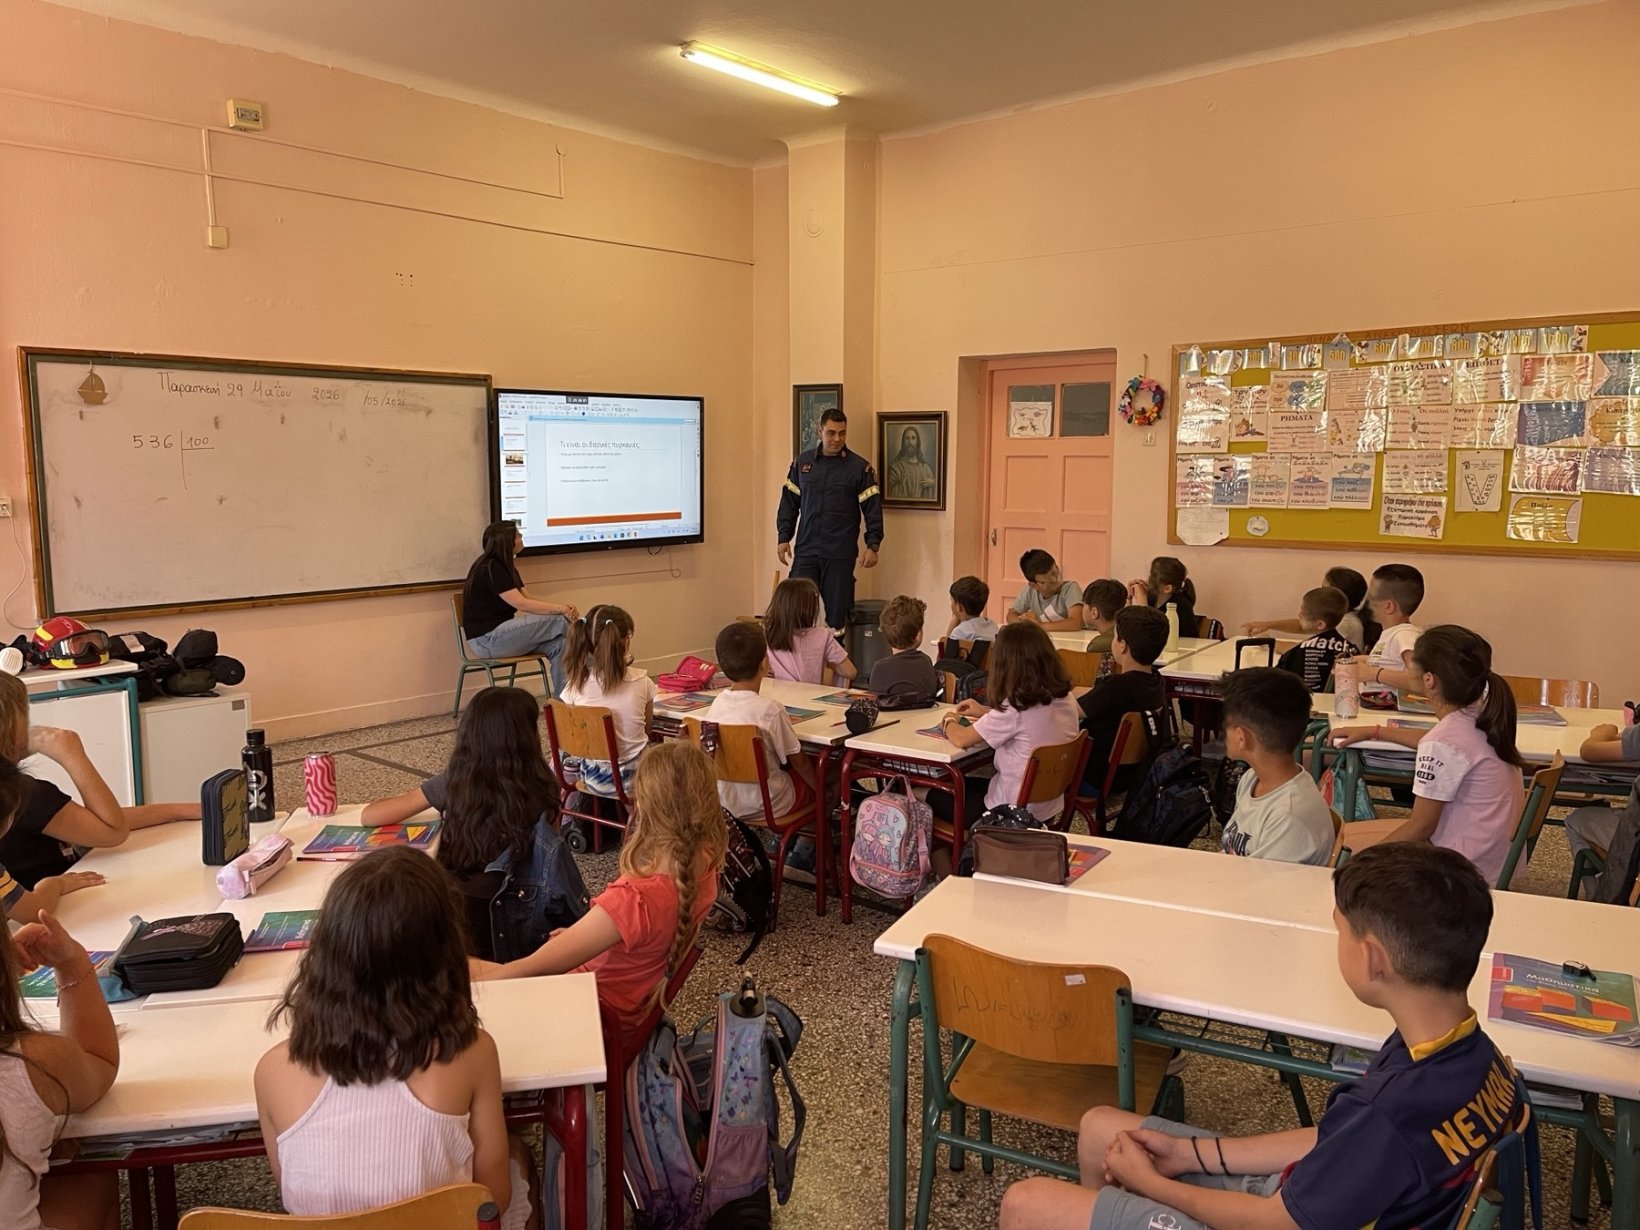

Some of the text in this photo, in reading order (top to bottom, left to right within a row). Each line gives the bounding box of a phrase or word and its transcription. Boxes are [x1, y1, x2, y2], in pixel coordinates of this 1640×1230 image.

[157, 371, 221, 397] Παρασκευή
[227, 383, 243, 397] 29
[312, 388, 340, 401] 2026
[1280, 414, 1313, 422] ΡΗΜΑΤΑ
[186, 436, 209, 448] 100
[1418, 755, 1435, 763] KEEP
